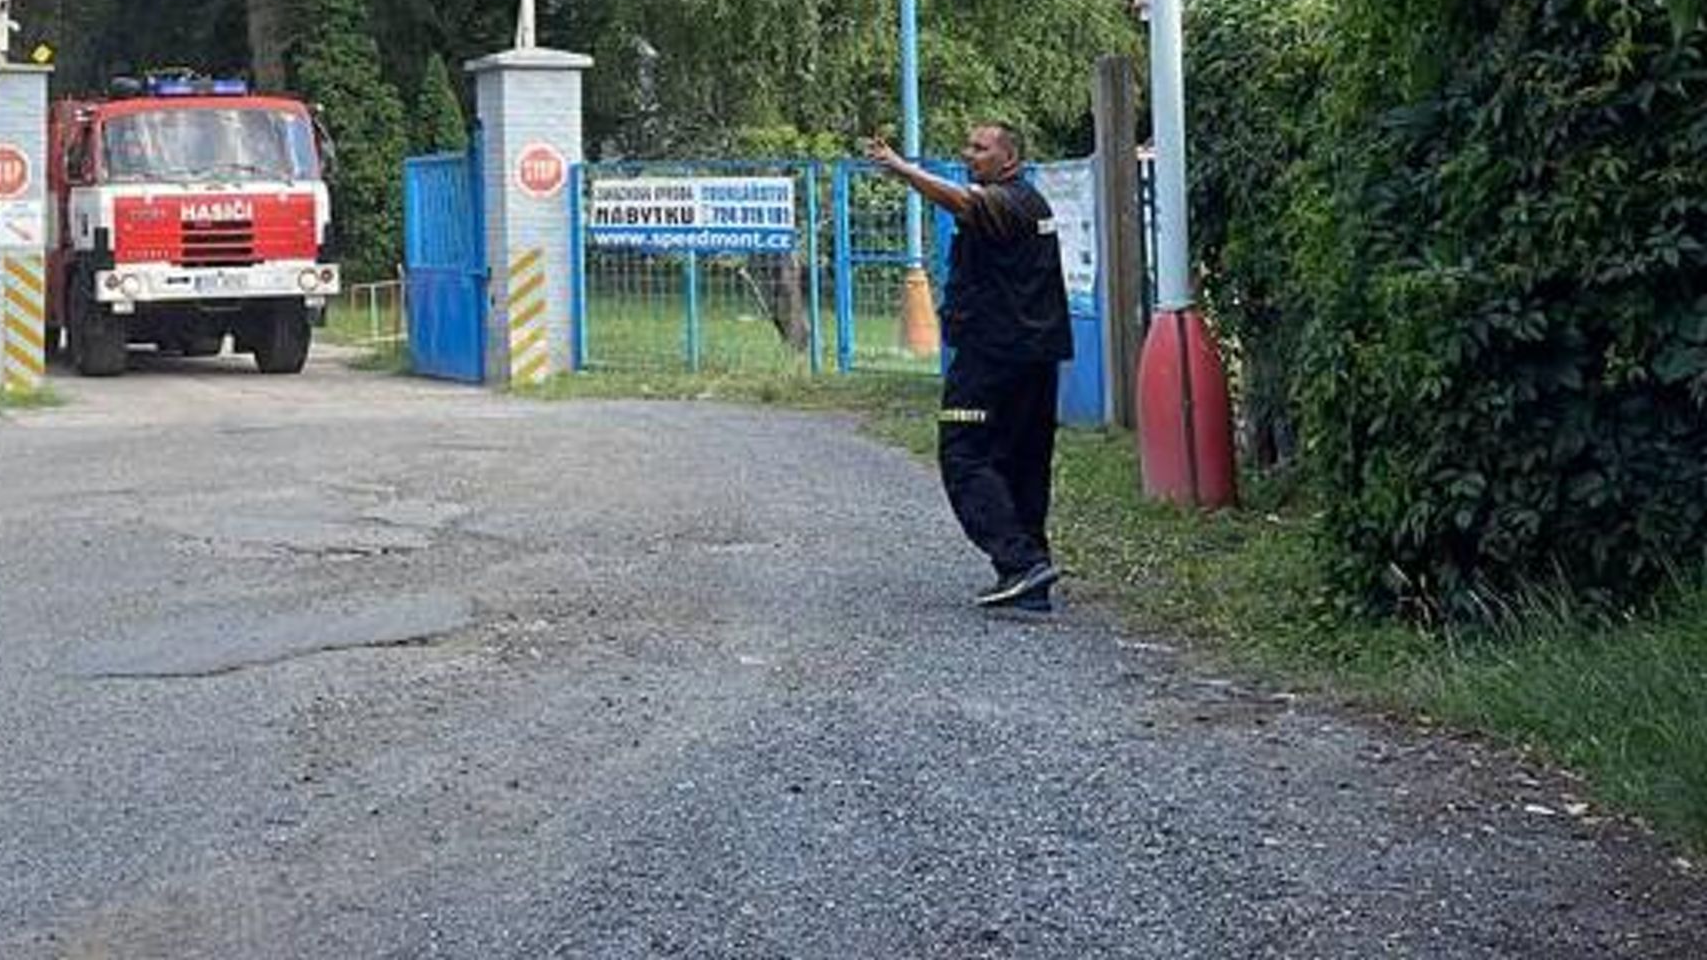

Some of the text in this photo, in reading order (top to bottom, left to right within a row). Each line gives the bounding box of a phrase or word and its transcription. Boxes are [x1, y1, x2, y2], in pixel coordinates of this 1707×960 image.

[522, 159, 560, 181] STOP
[180, 198, 254, 221] HASIČI
[595, 230, 794, 249] www.speedmont.cz
